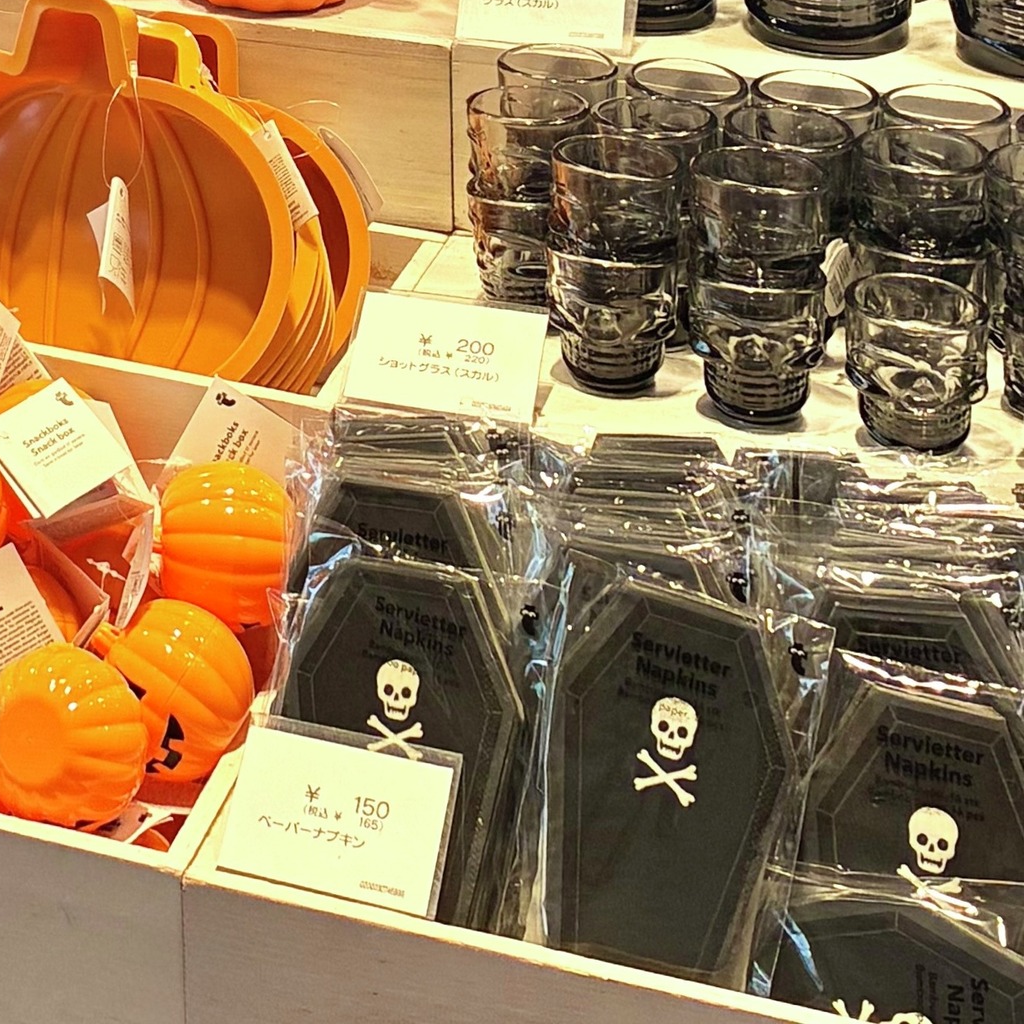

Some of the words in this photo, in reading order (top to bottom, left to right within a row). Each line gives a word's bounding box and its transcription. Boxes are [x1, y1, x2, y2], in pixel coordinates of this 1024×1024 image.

[418, 333, 433, 347] ¥
[456, 338, 495, 356] 200
[22, 418, 69, 449] Snackboks
[30, 437, 57, 457] Snack
[56, 427, 75, 441] box
[212, 421, 240, 462] ackboks
[233, 428, 249, 448] box
[375, 595, 467, 641] Servietter
[379, 618, 454, 657] Napkins
[631, 631, 732, 678] Servietter
[636, 655, 719, 699] Napkins
[877, 725, 985, 766] Servietter
[884, 750, 974, 788] Napkins
[305, 784, 321, 803] ¥
[354, 796, 390, 821] 150
